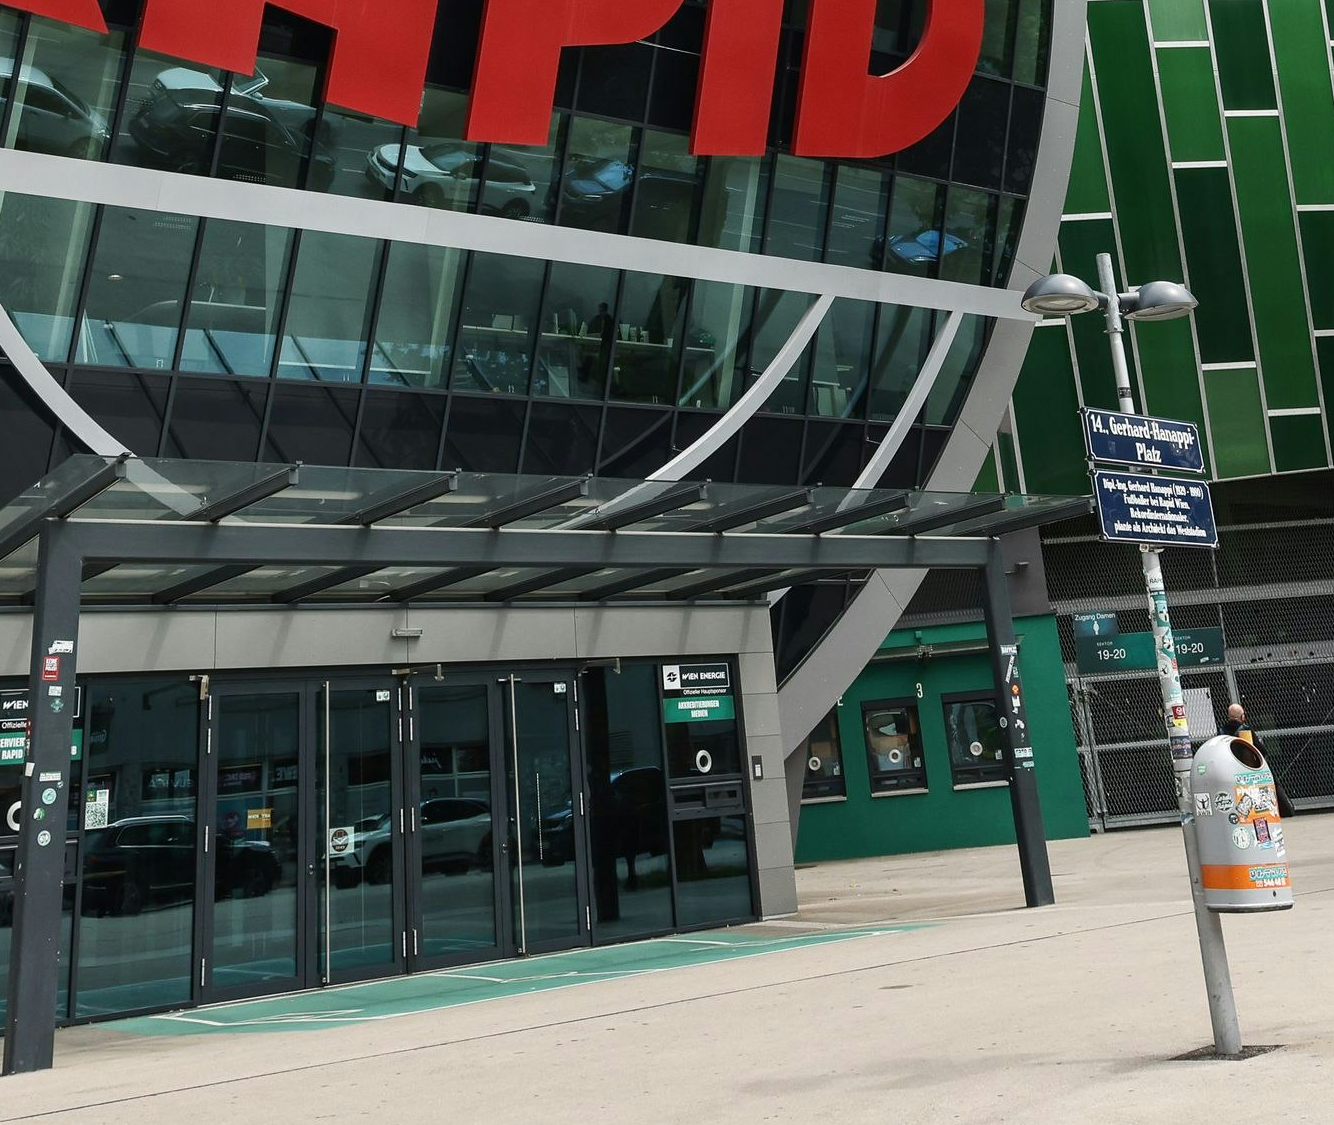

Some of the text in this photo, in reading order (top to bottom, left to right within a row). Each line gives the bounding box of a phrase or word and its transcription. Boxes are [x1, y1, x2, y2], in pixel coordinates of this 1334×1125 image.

[1109, 416, 1195, 450] Gerhard-Hanappi-
[1135, 442, 1162, 463] Platz
[1127, 480, 1150, 492] Gerhard
[1150, 482, 1173, 497] Hanappi
[1123, 493, 1149, 506] Fußballer
[1149, 495, 1159, 506] bei
[1159, 496, 1175, 510] Rapid
[1114, 520, 1207, 537] plante als Architekt das Weststadion
[1074, 612, 1116, 622] Zugang Damen
[1097, 648, 1126, 661] 19-20
[1175, 642, 1204, 655] 19-20
[915, 682, 924, 699] 3
[2, 700, 29, 710] WIEN
[1, 748, 24, 760] RAPID
